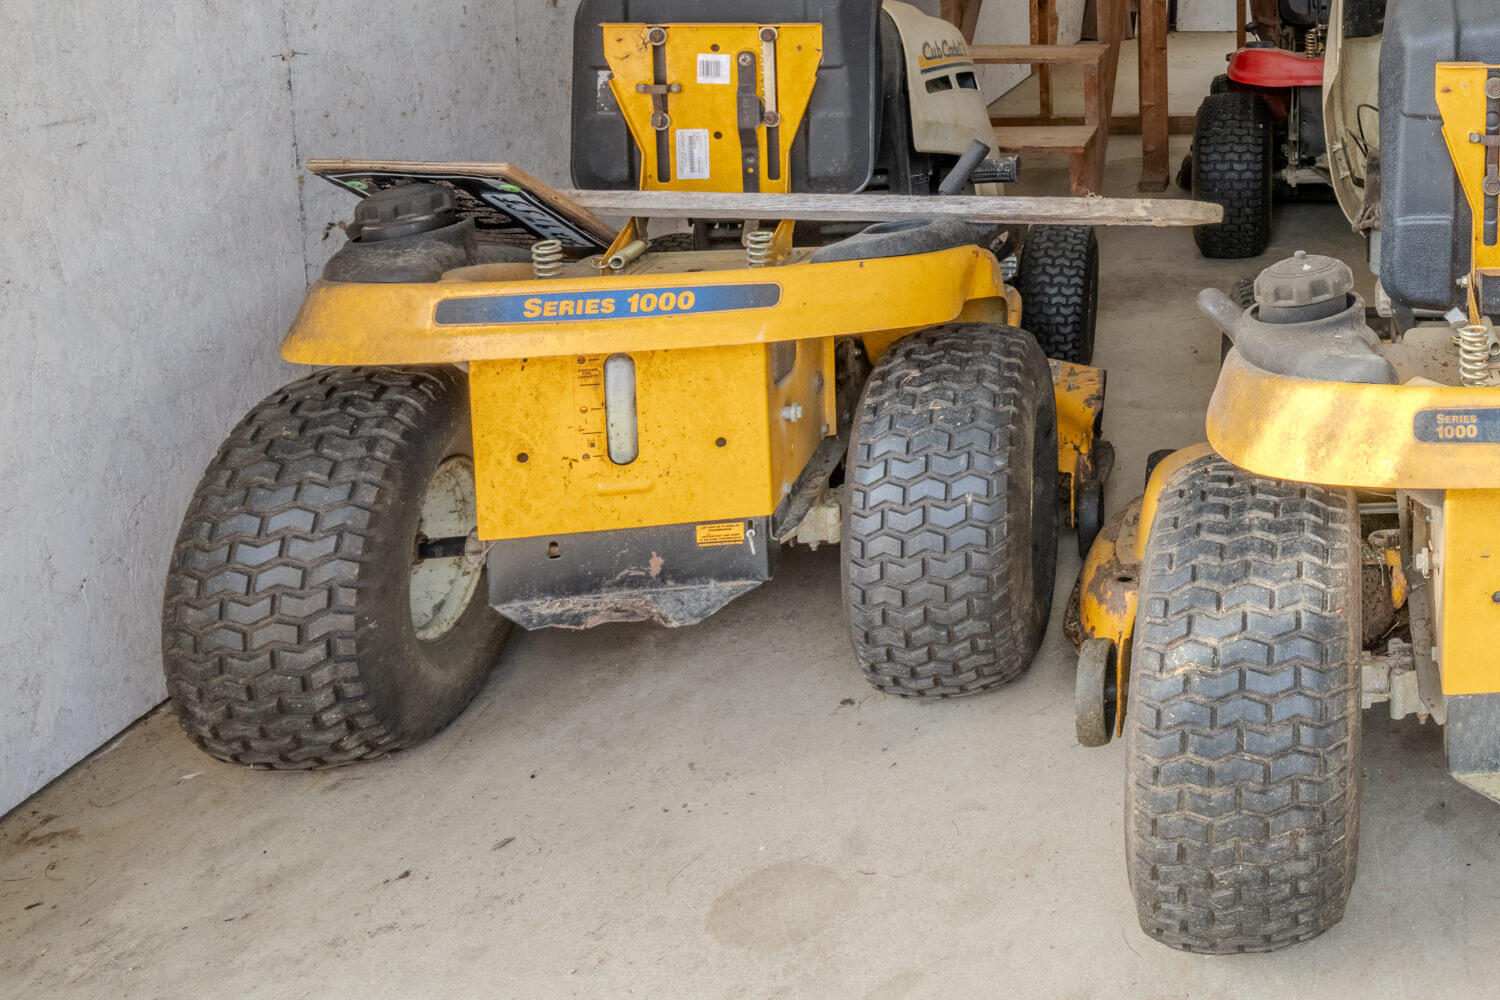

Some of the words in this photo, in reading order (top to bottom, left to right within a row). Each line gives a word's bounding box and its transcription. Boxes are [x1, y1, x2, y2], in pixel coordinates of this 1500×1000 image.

[922, 40, 943, 60] Cub
[522, 297, 616, 318] SERIES
[627, 290, 696, 313] 1000
[1436, 413, 1478, 424] SERIES
[1436, 424, 1478, 440] 1000
